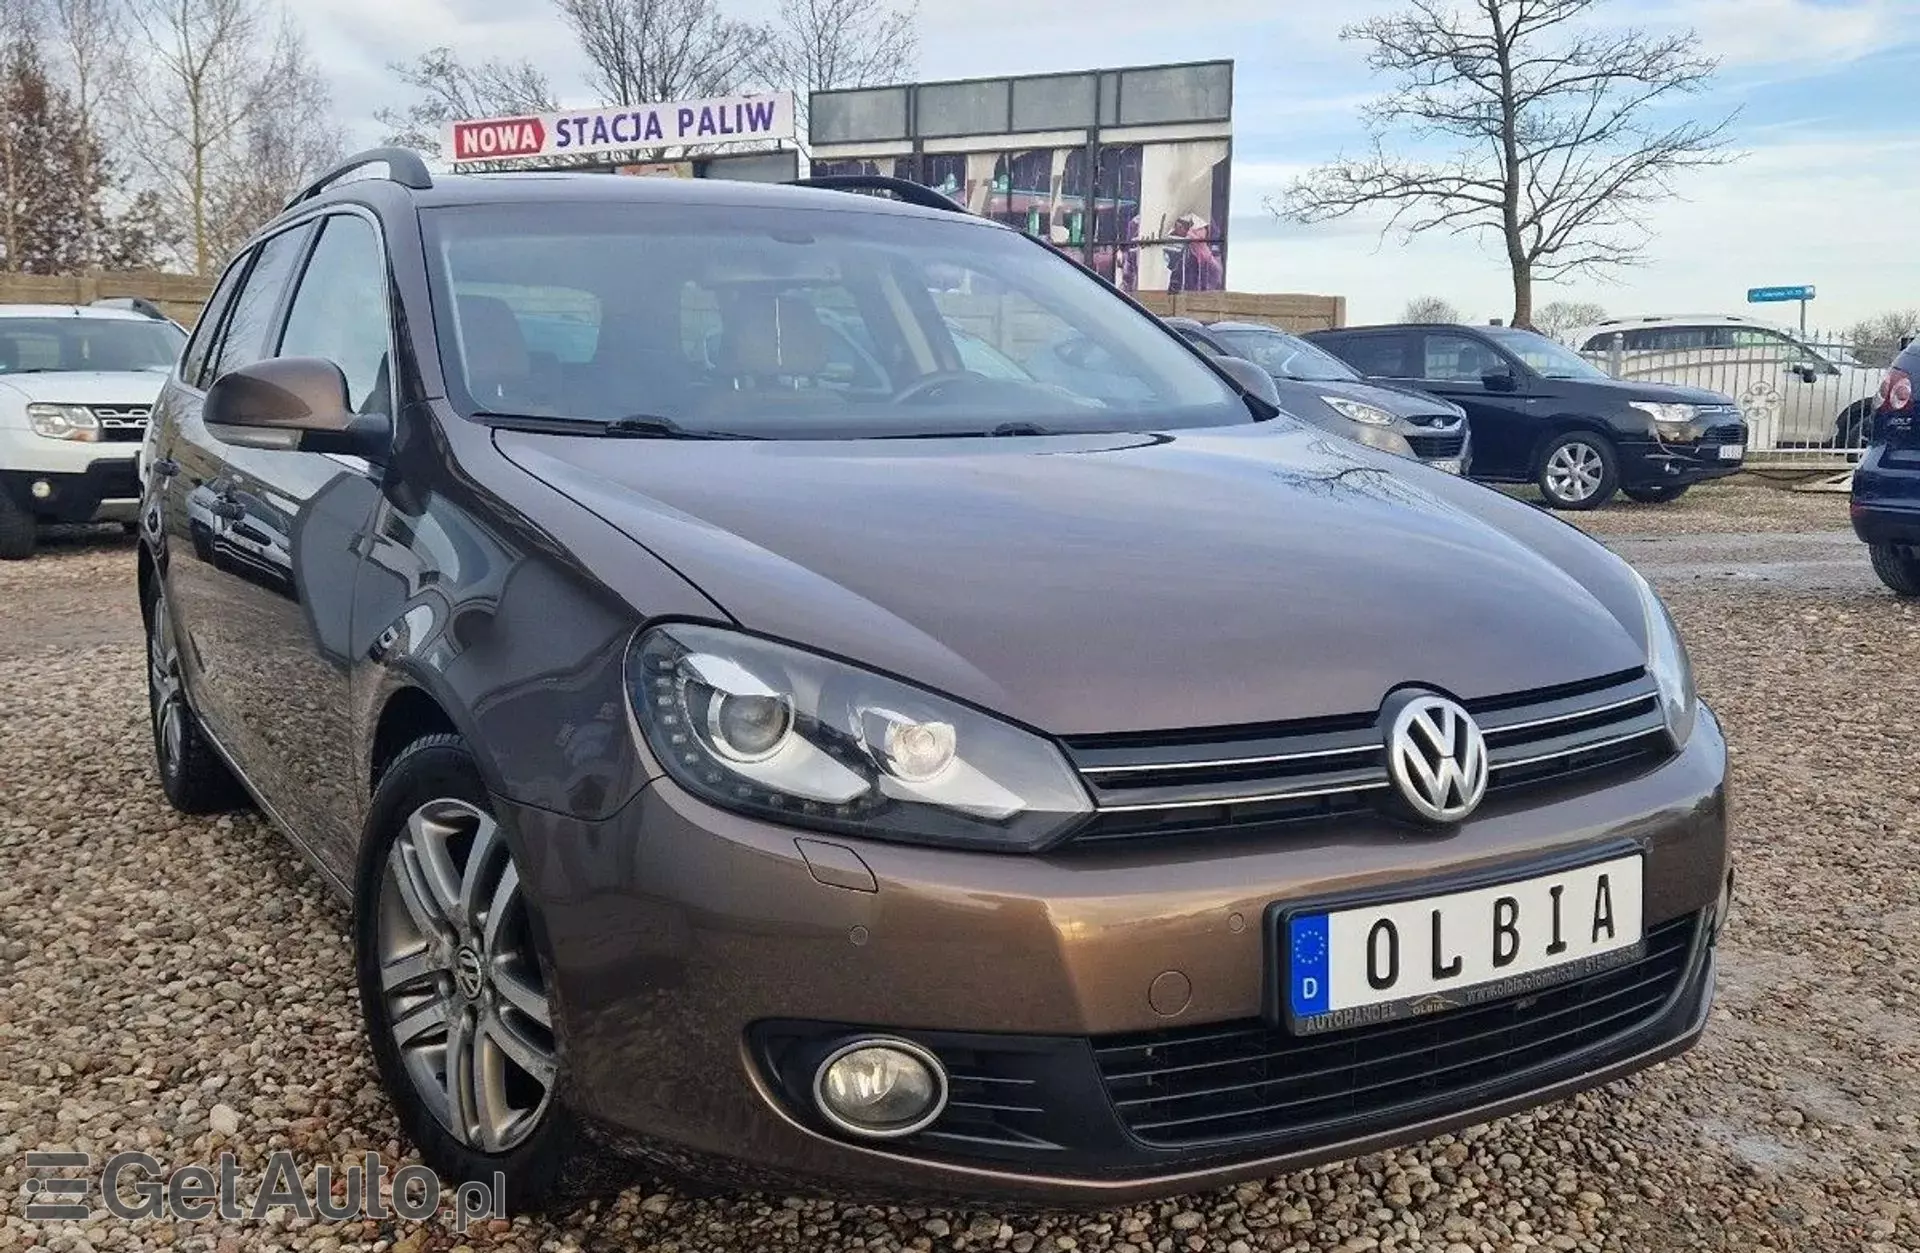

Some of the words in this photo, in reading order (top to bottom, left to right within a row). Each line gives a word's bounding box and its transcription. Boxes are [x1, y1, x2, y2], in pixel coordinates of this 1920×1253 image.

[463, 124, 537, 153] NOWA
[556, 111, 663, 148] STACJA
[678, 101, 775, 137] PALIW
[1366, 874, 1616, 990] OLBIA
[1302, 976, 1319, 1000] D
[1306, 1003, 1397, 1032] AUTOHANDEL
